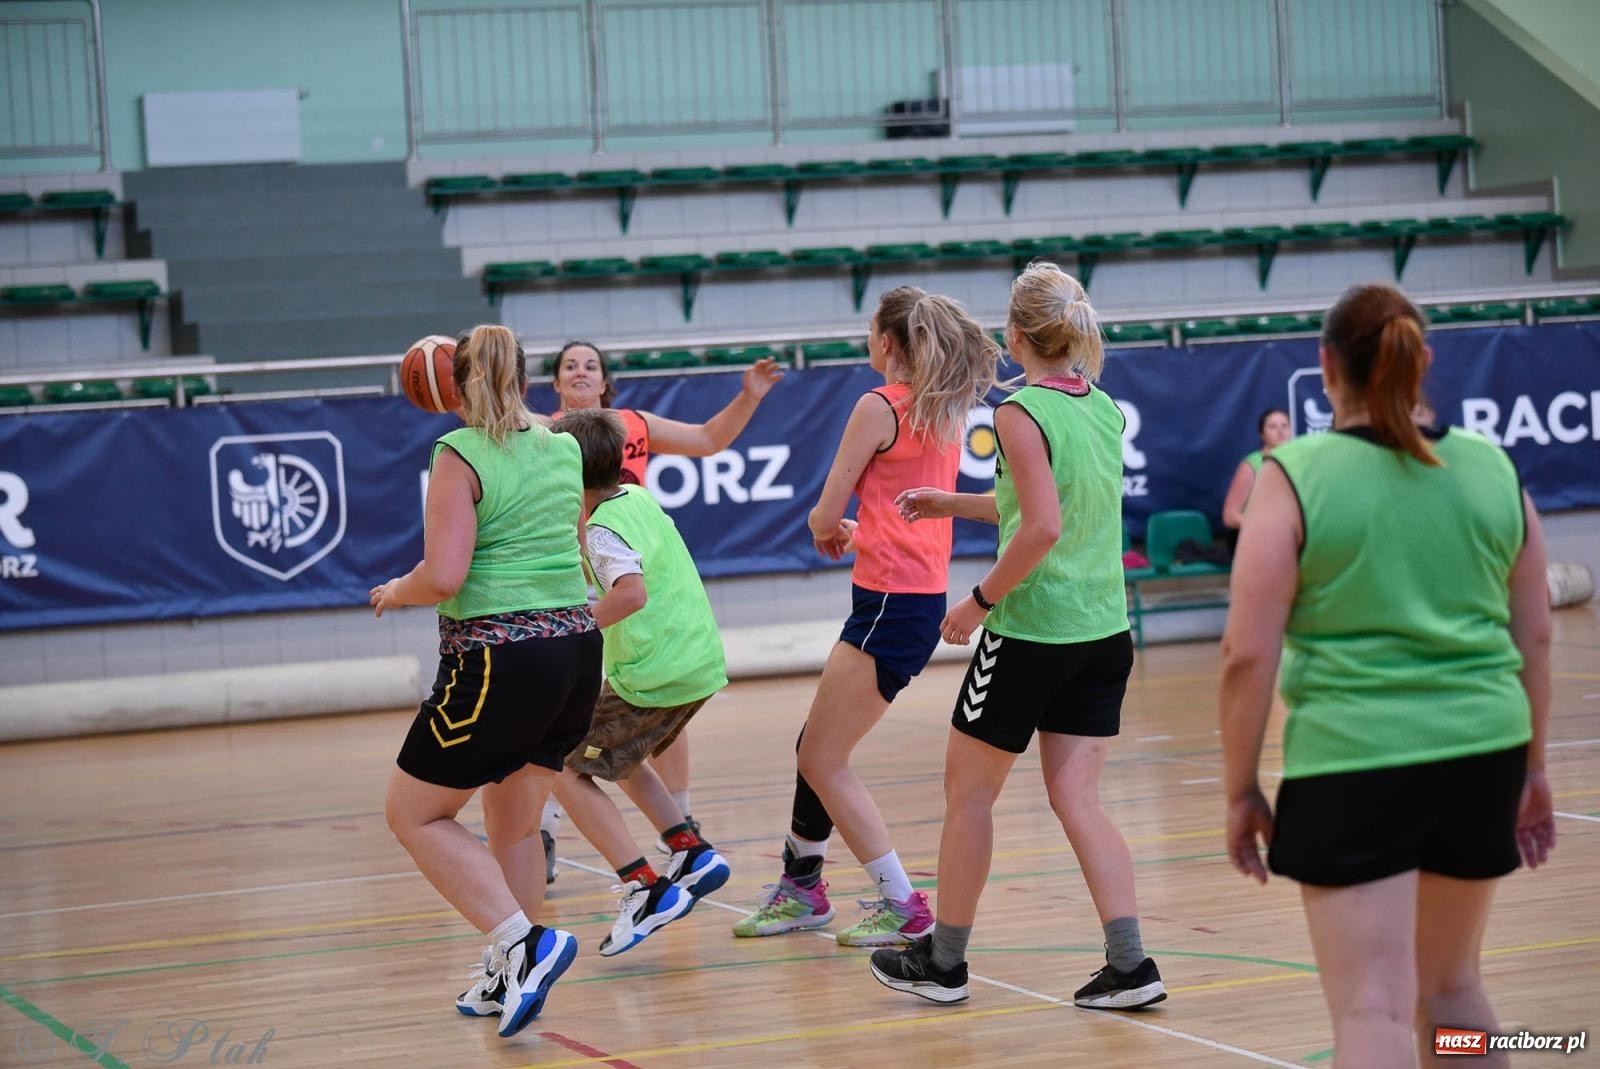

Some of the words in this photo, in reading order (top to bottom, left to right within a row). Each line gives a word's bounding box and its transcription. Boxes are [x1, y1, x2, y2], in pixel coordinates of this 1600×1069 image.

[625, 438, 646, 459] 22
[646, 444, 794, 509] ORZ
[0, 553, 39, 578] RZ
